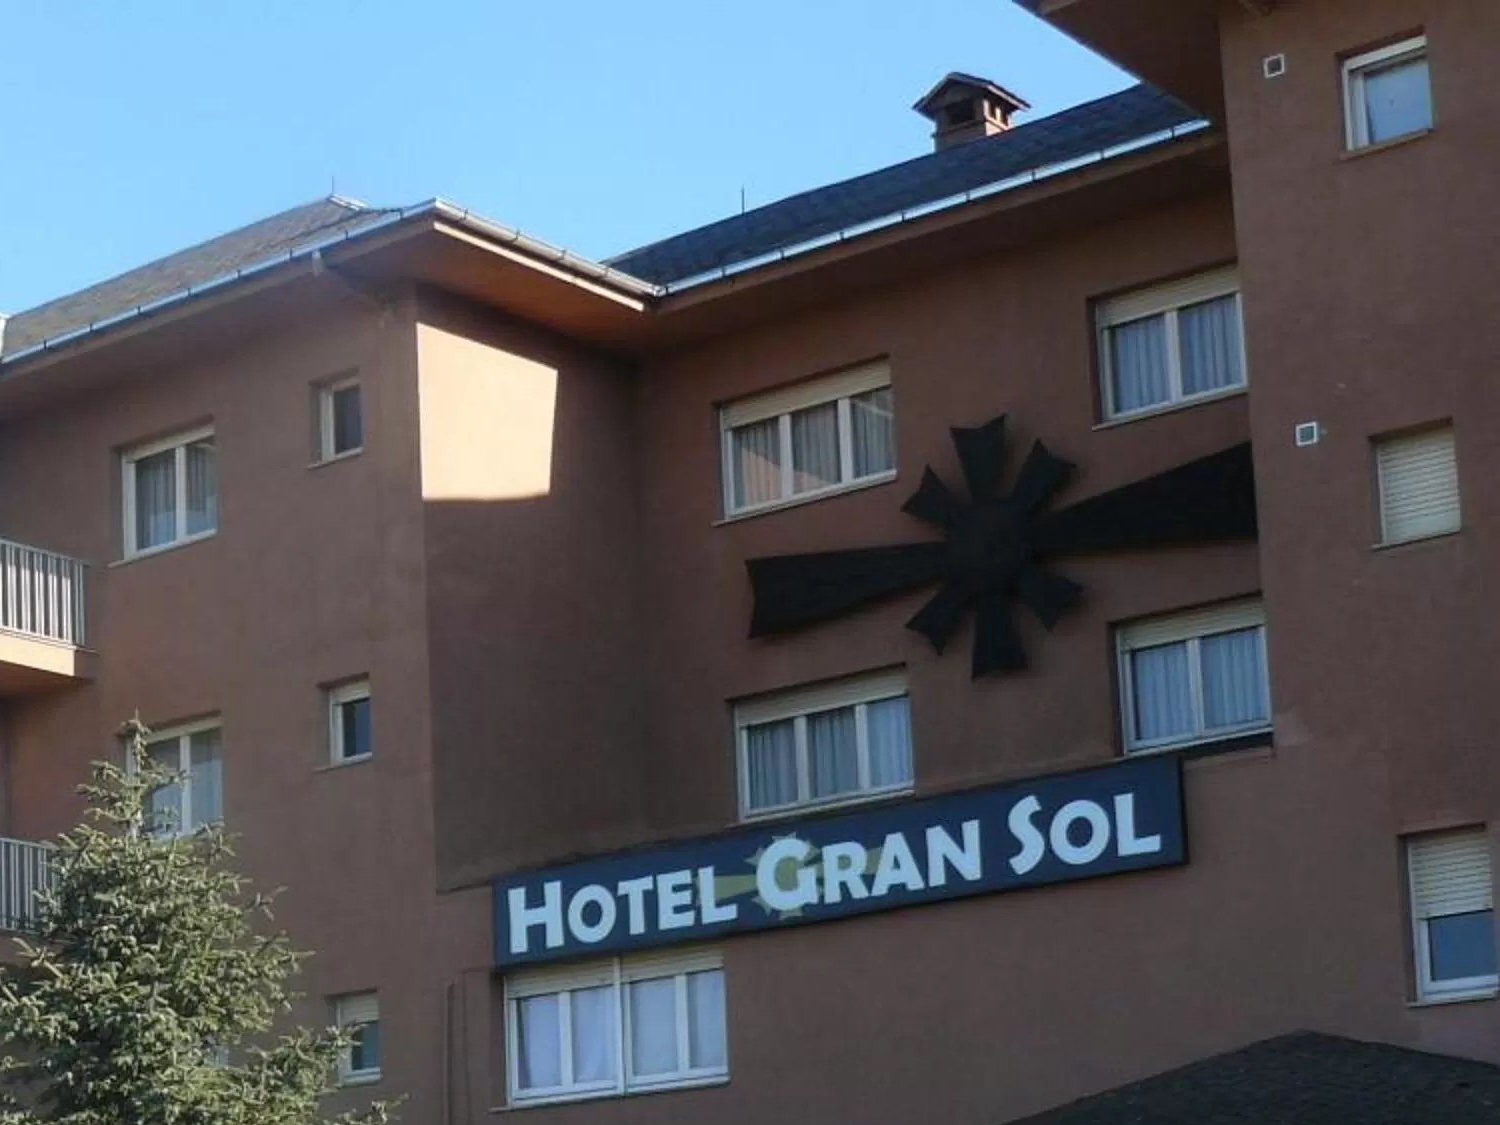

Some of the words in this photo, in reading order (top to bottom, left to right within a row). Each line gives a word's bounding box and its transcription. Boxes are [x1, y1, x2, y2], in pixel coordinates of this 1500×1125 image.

[507, 865, 738, 954] HOTEL
[755, 819, 982, 912] GRAN
[1007, 793, 1162, 877] SOL
